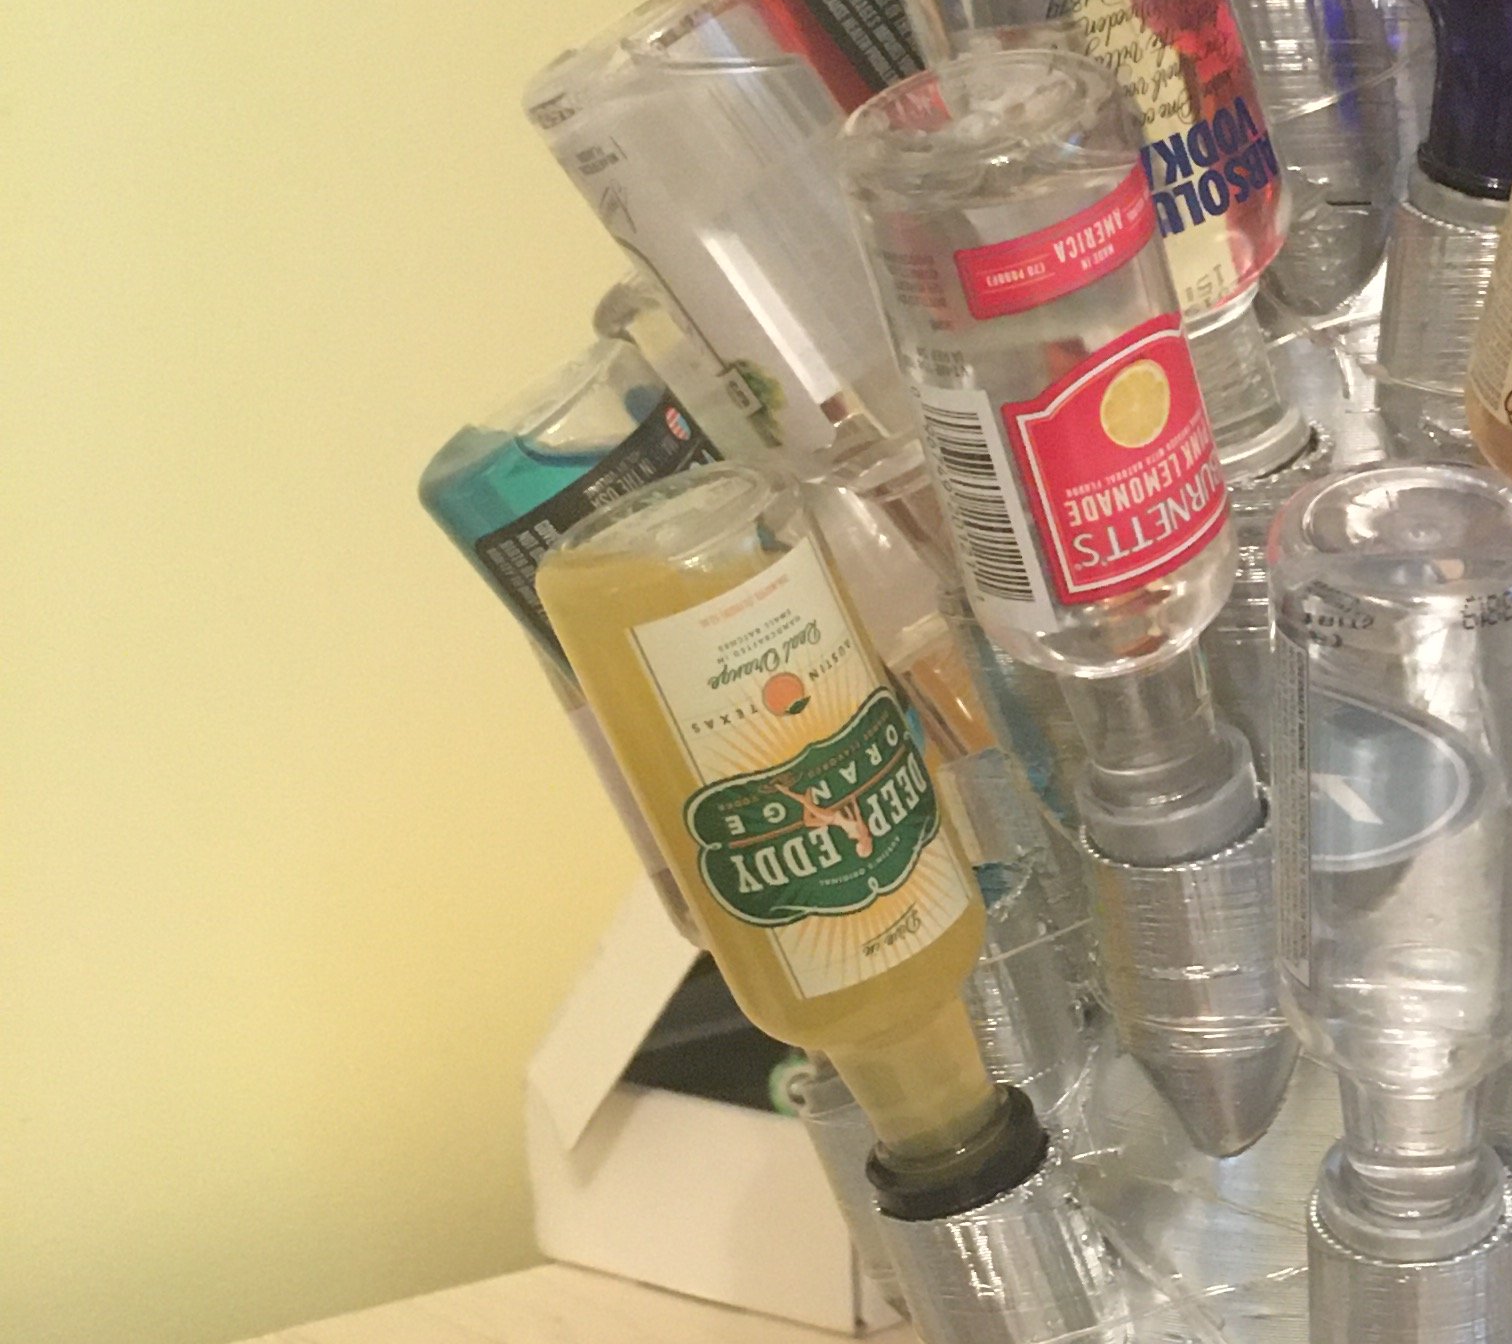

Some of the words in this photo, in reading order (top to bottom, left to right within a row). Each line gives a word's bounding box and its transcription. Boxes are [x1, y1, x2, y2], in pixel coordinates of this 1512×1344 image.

[1152, 131, 1277, 238] ABSOLU
[1052, 207, 1124, 263] AMERICA
[1063, 452, 1181, 527] LEMONADE
[707, 647, 780, 690] Orange
[782, 619, 822, 664] Real
[808, 638, 851, 682] AUSTIN
[691, 703, 758, 734] TEXAS
[724, 724, 899, 835] ORANGE
[866, 751, 927, 838] DEEP
[729, 824, 843, 893] EDDY
